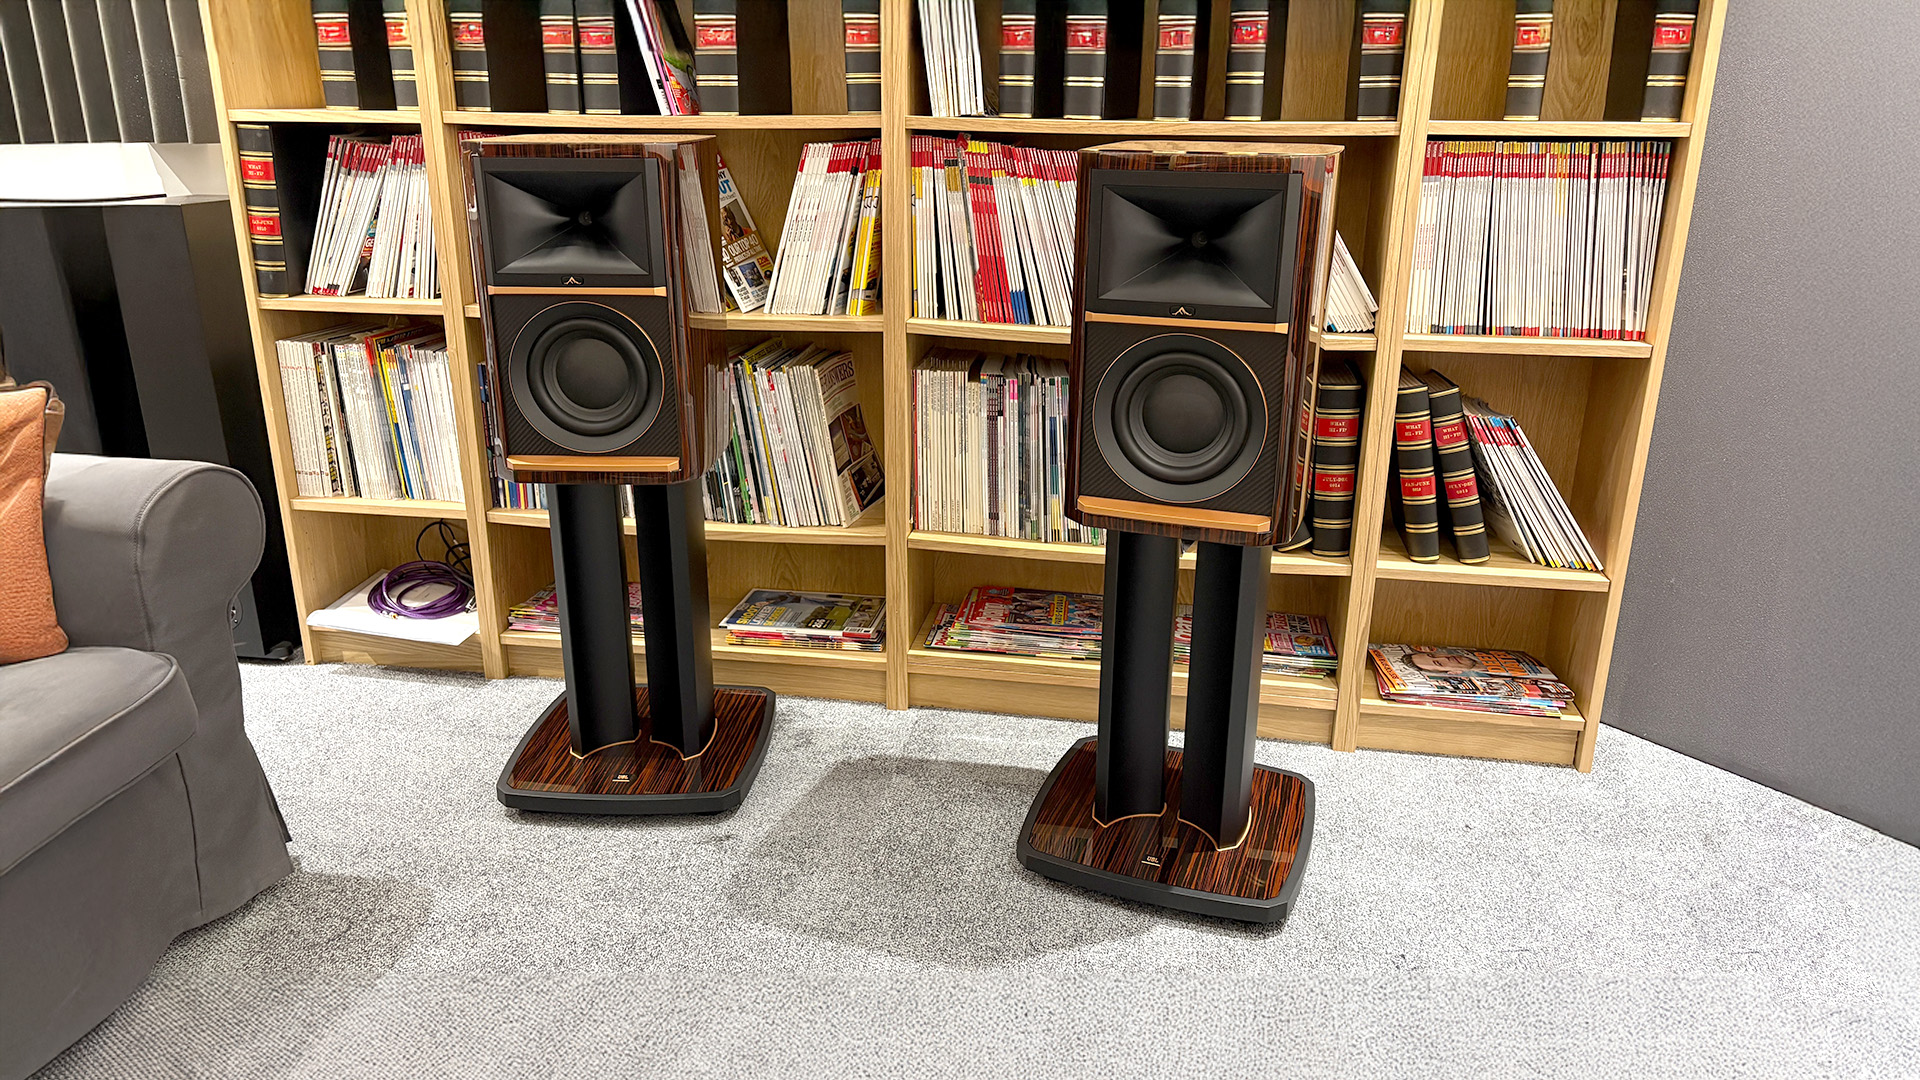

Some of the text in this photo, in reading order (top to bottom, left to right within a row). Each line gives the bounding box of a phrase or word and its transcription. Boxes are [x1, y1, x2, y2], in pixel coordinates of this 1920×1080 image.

[728, 233, 759, 256] OUR TOP 40
[736, 605, 758, 624] SHOOT
[749, 605, 774, 625] LOWER
[1474, 651, 1507, 673] DEEP
